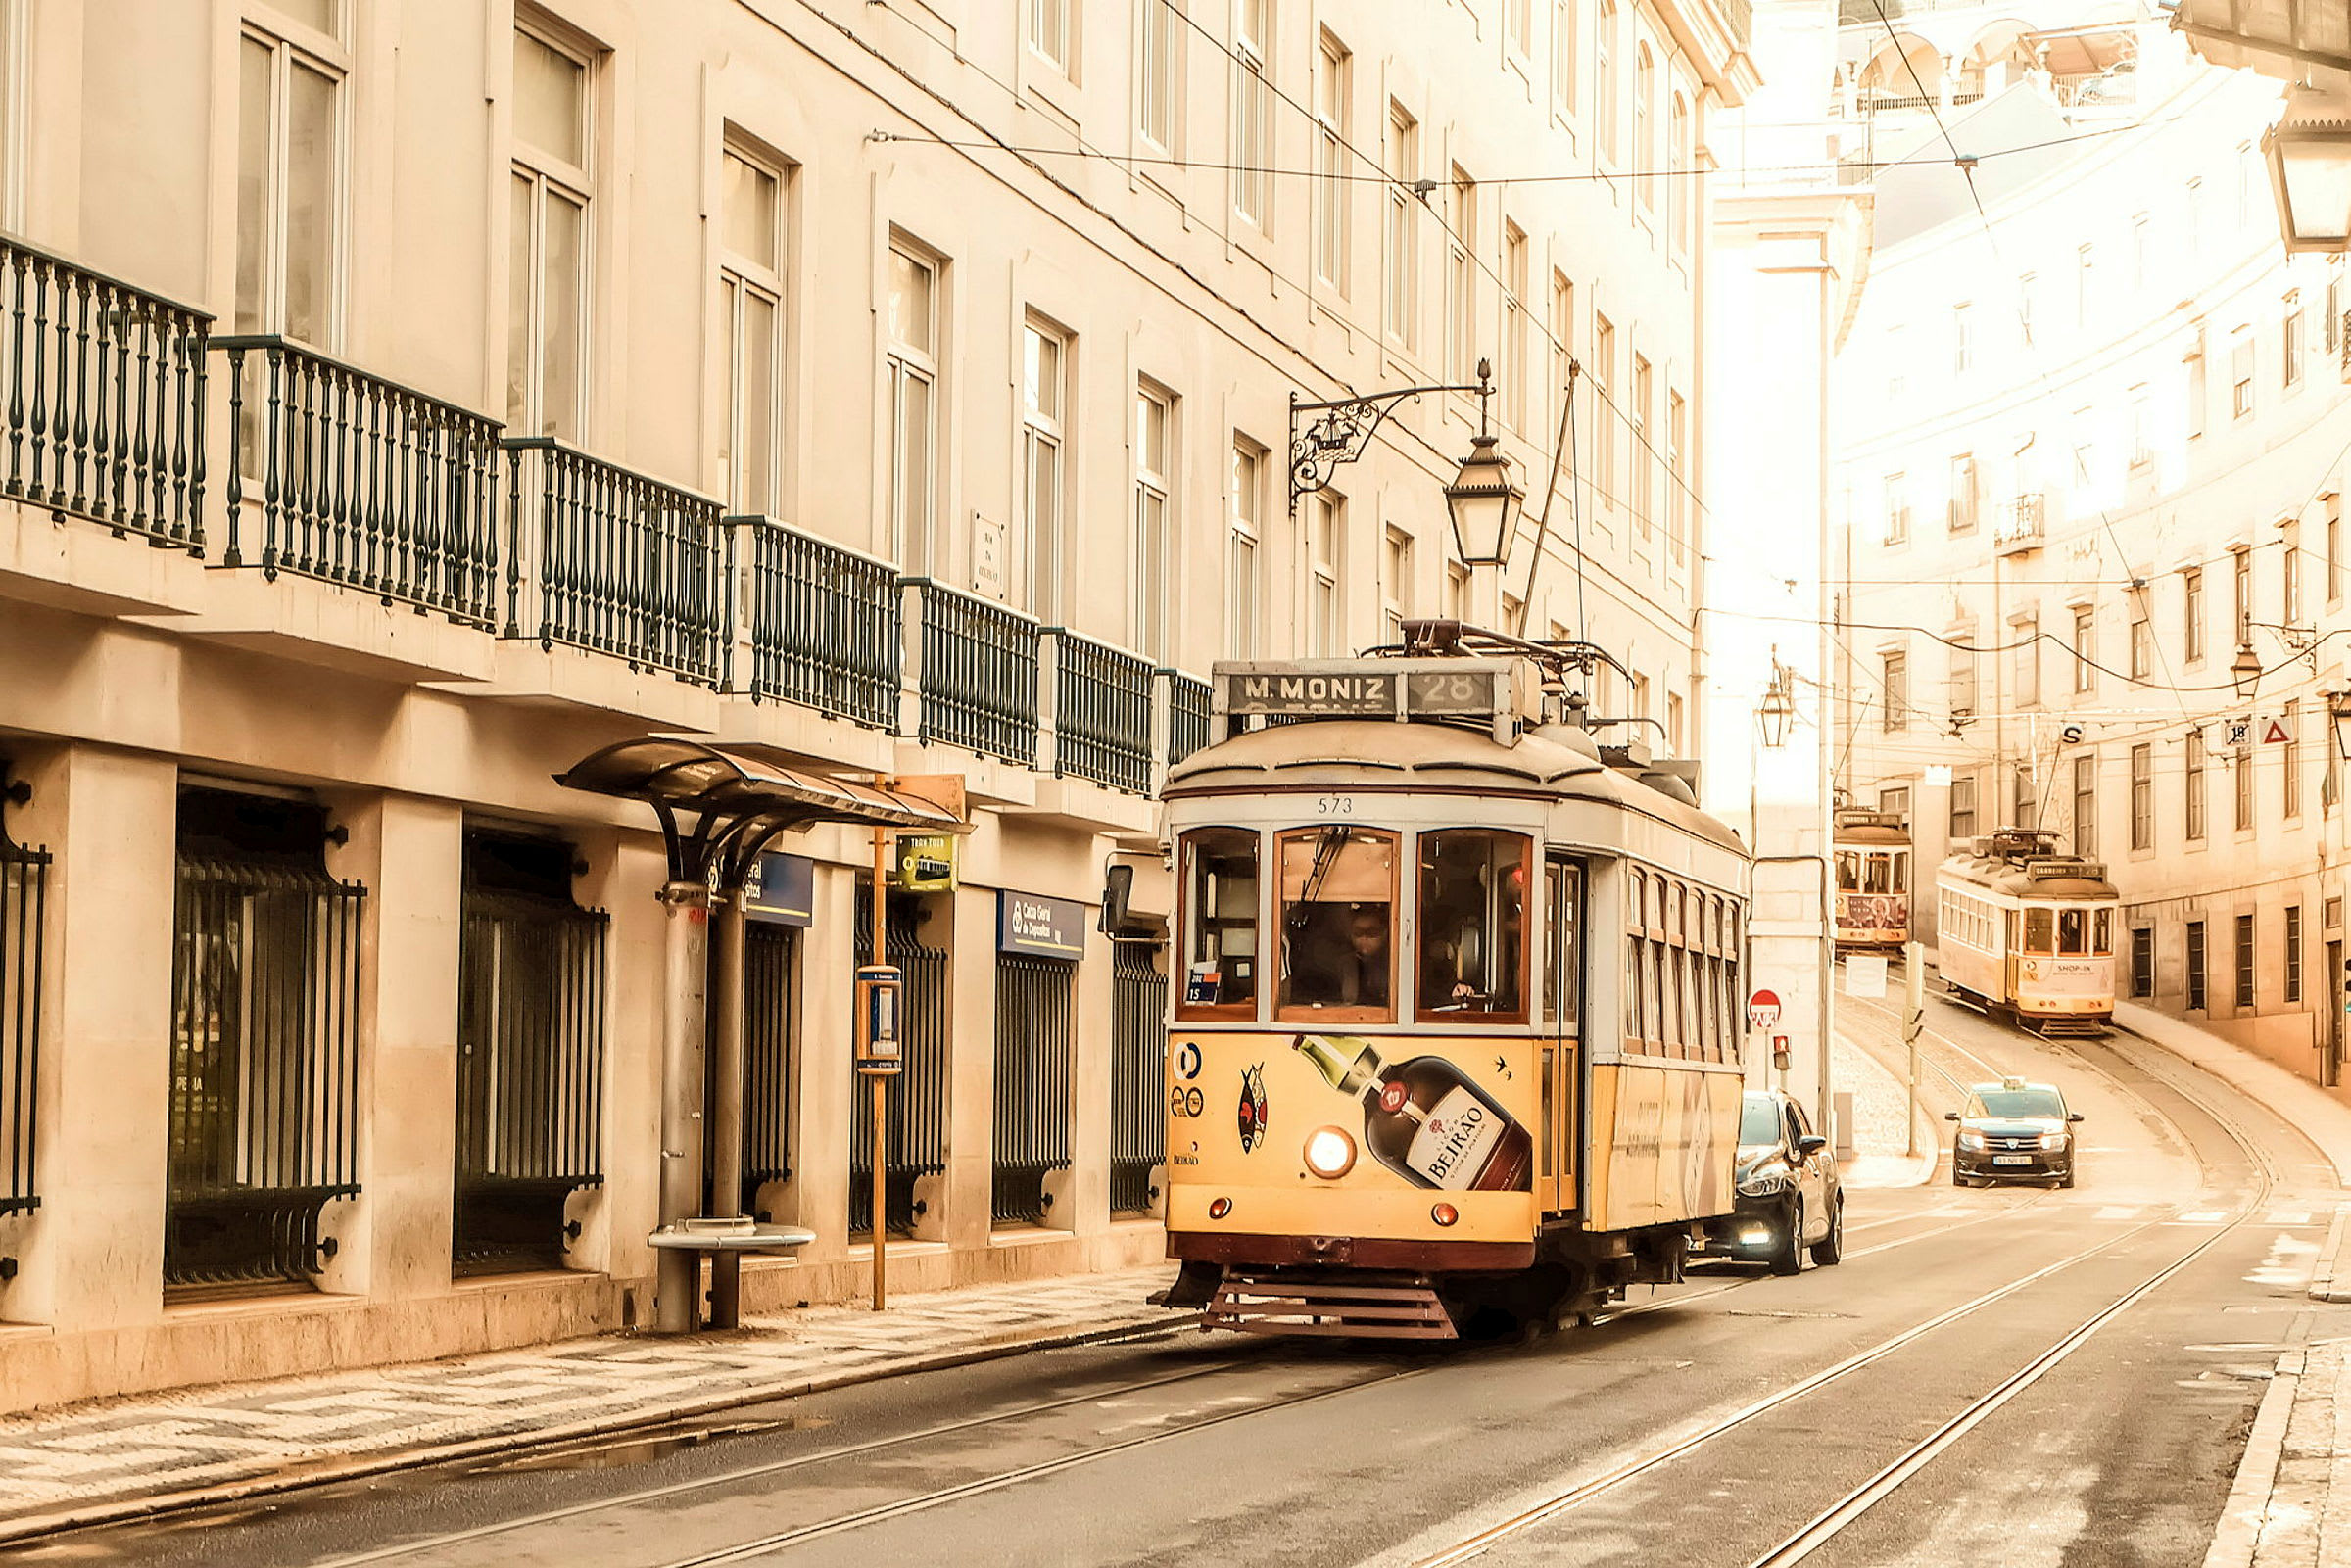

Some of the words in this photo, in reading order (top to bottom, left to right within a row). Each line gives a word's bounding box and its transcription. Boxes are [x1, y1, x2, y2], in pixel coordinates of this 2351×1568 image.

[1280, 677, 1384, 700] MONIZ
[1423, 675, 1474, 702] 28
[2062, 727, 2083, 744] S
[1319, 797, 1352, 814] 573
[1428, 1106, 1483, 1180] BEIRÃO
